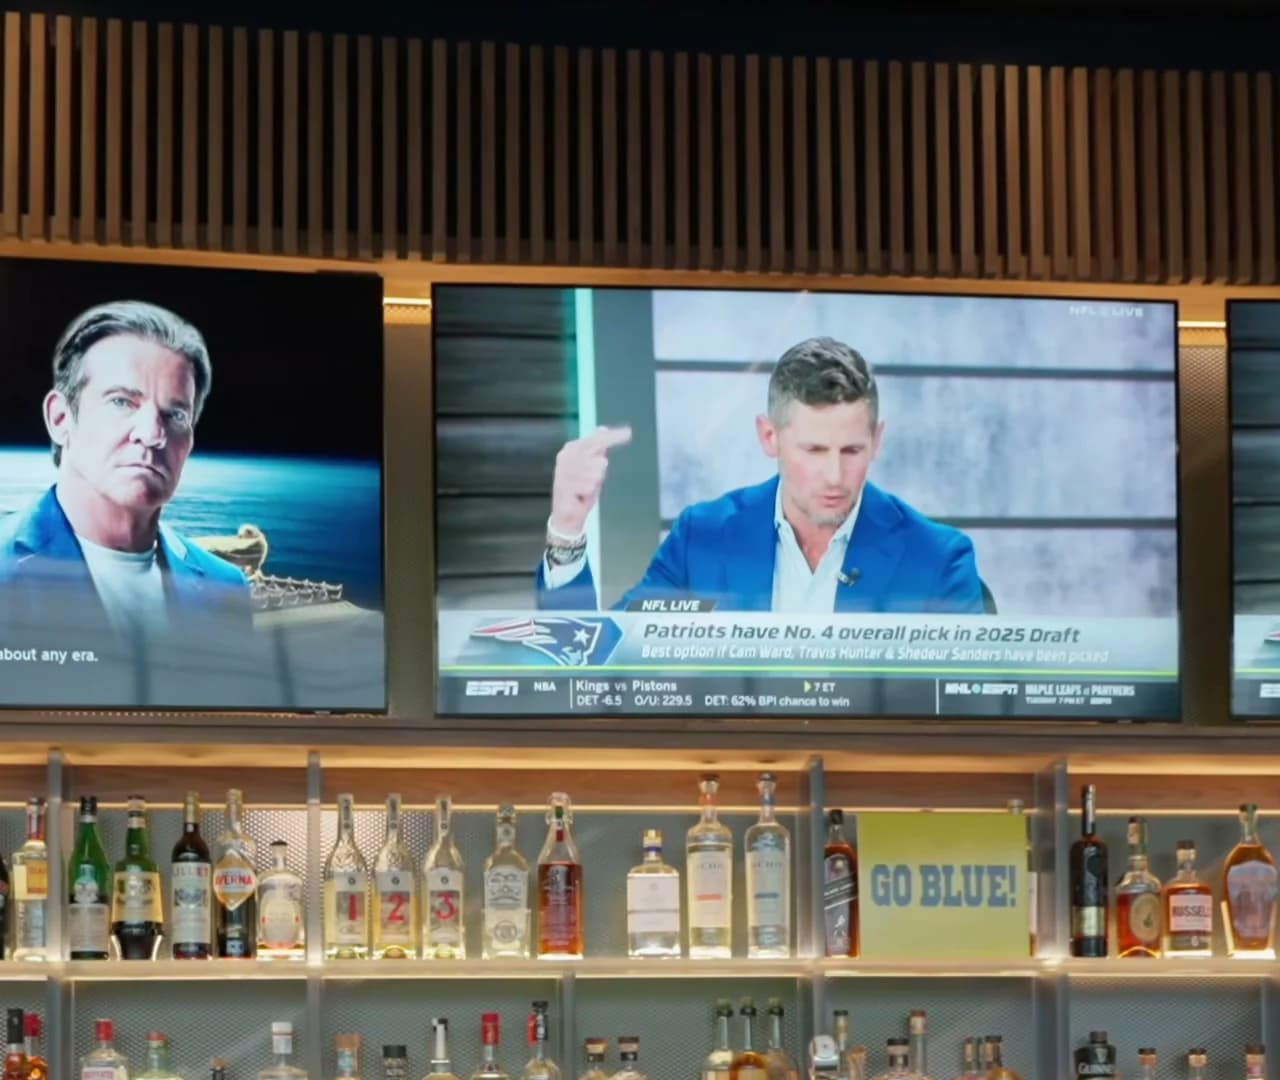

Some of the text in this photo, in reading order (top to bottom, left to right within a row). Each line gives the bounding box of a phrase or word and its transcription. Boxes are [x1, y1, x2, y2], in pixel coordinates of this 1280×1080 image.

[641, 599, 701, 612] NFL LIVE
[643, 622, 1081, 644] Patriots have No. 4 overall pick in 2025 Draft
[41, 649, 68, 664] any
[72, 650, 99, 662] era.
[641, 644, 671, 658] Best
[674, 645, 714, 661] option
[729, 645, 756, 659] Cam
[798, 645, 836, 660] Travis
[839, 646, 882, 661] Hunter
[897, 647, 949, 661] Shedeur
[951, 648, 1001, 662] Sanders
[1004, 648, 1033, 662] have
[465, 680, 519, 697] ESPN
[533, 680, 557, 692] NBA
[575, 679, 678, 695] Kings vs Pistons
[1024, 684, 1054, 697] MAPLE
[1055, 684, 1082, 697] LEAFS
[1091, 685, 1136, 698] PANTHERS
[576, 694, 600, 707] DET
[662, 695, 693, 707] 229.5
[779, 695, 817, 708] chance
[818, 696, 830, 707] to
[831, 696, 850, 708] win
[871, 864, 1017, 909] GO BLUE!
[348, 893, 358, 922] 1
[387, 893, 406, 922] 2
[435, 892, 459, 921] 3
